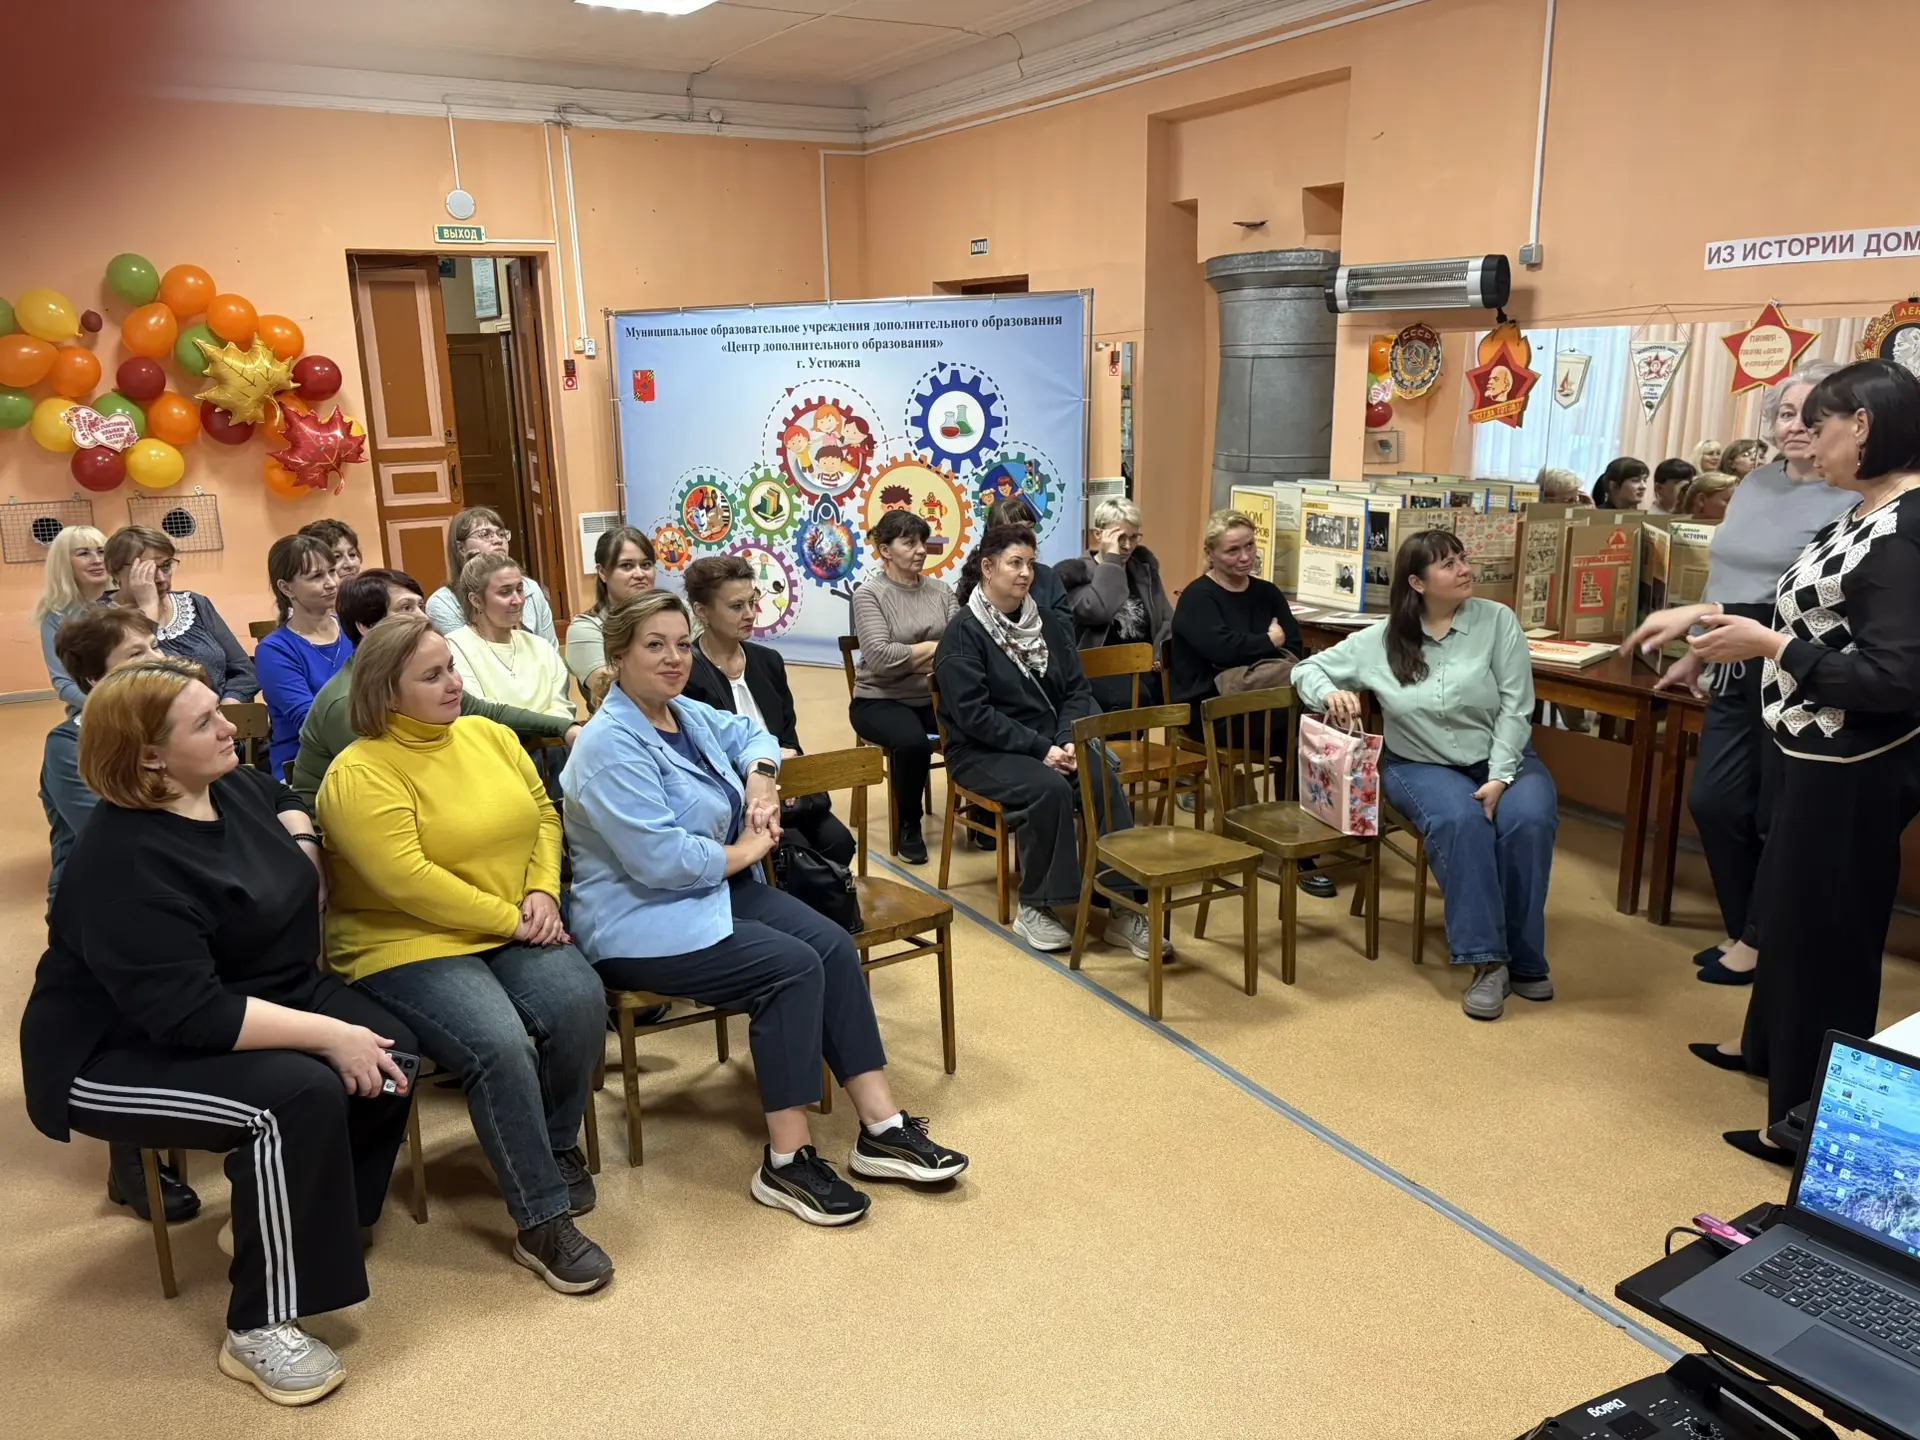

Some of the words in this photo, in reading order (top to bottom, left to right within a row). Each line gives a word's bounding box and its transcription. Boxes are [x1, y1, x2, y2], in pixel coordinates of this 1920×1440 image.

[443, 228, 478, 240] ВЫХОД
[1707, 244, 1735, 265] ИЗ
[1742, 233, 1854, 262] ИСТОРИИ
[1863, 230, 1920, 257] ДОМ
[625, 326, 708, 340] Муниципальное
[711, 323, 800, 338] образовательное
[803, 320, 870, 336] учреждения
[873, 318, 978, 332] дополнительного
[982, 315, 1062, 331] образования
[1402, 328, 1432, 340] СССР
[721, 340, 760, 354] «Центр
[763, 339, 859, 353] дополнительного
[862, 338, 943, 352] образования»
[797, 360, 806, 369] г.
[808, 357, 861, 369] Устюжна
[1244, 510, 1263, 525] ОМ
[1586, 1398, 1627, 1417] Dialog
